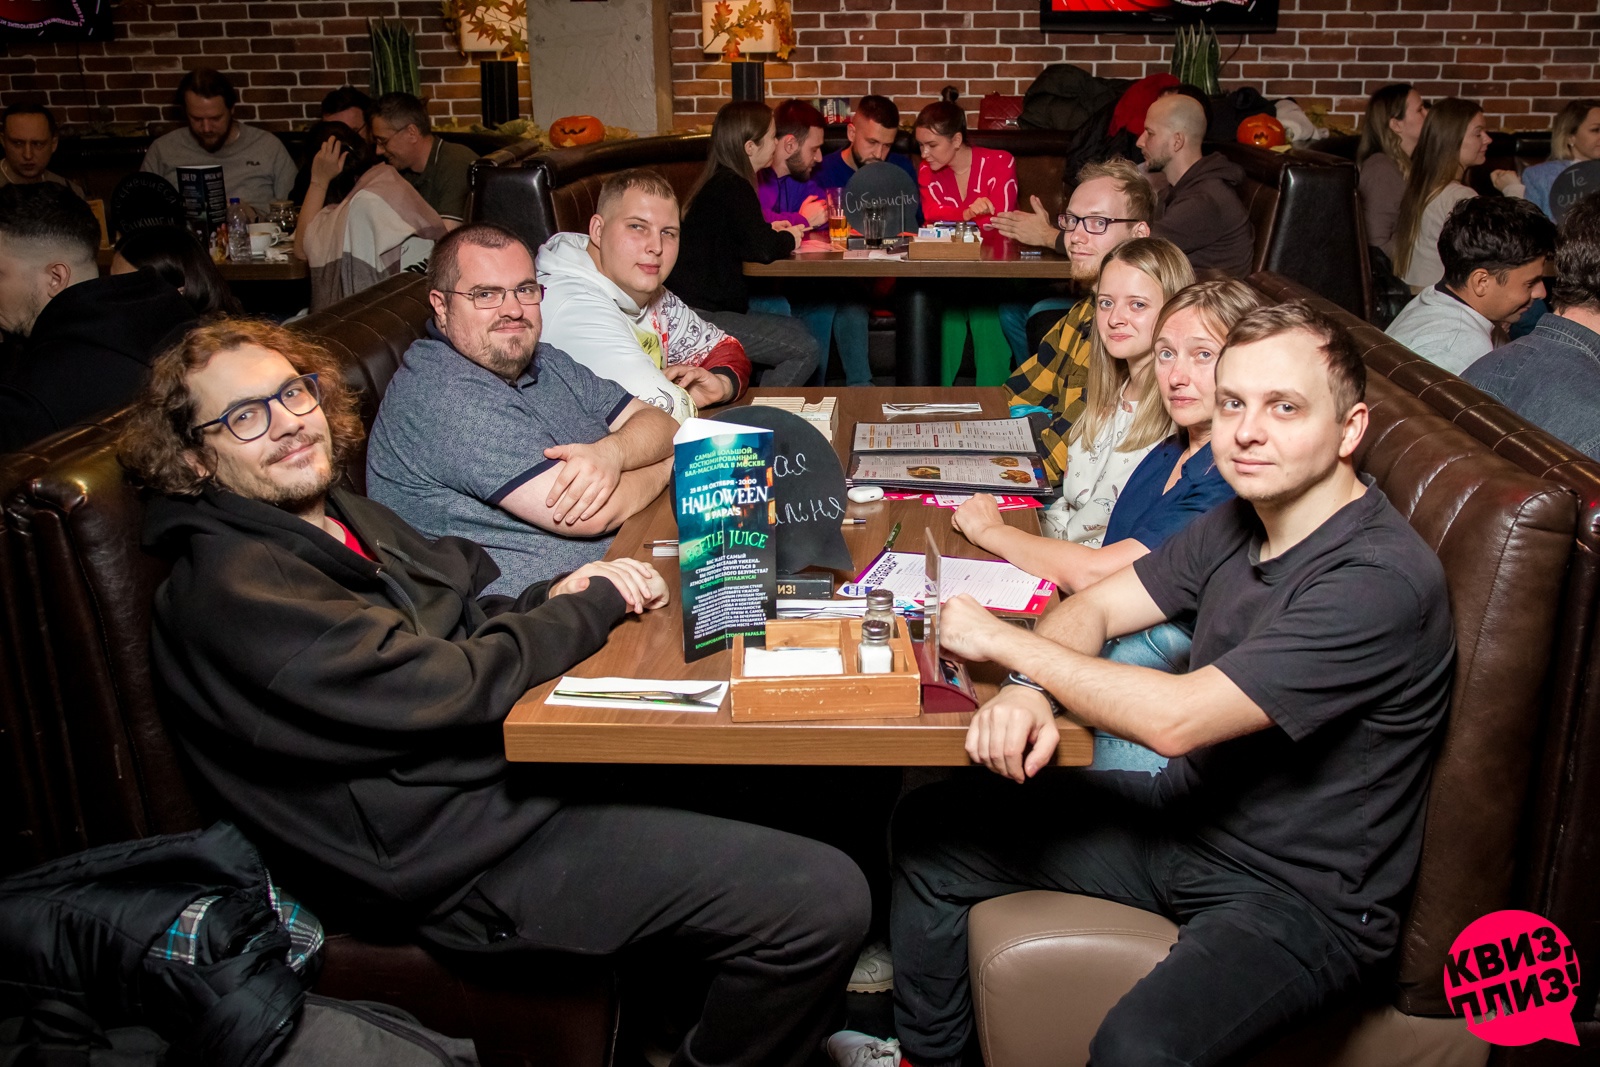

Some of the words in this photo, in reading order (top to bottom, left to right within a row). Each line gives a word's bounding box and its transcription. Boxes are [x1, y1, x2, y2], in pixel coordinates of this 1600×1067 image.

[695, 451, 716, 461] САМЫЙ
[717, 447, 752, 456] БОЛЬШОЙ
[685, 463, 730, 477] БАЛ-МАСКАРАД
[736, 460, 765, 468] МОСКВЕ
[689, 454, 758, 469] КОСТЮМИРОВАННЫЙ
[708, 479, 735, 489] ОКТЯБРЯ
[682, 486, 769, 515] HALLOWEEN
[712, 507, 742, 517] PAPA'S
[685, 530, 724, 562] BEETLE
[729, 530, 769, 549] JUICE
[738, 567, 768, 575] БЕЗУМСТВА?
